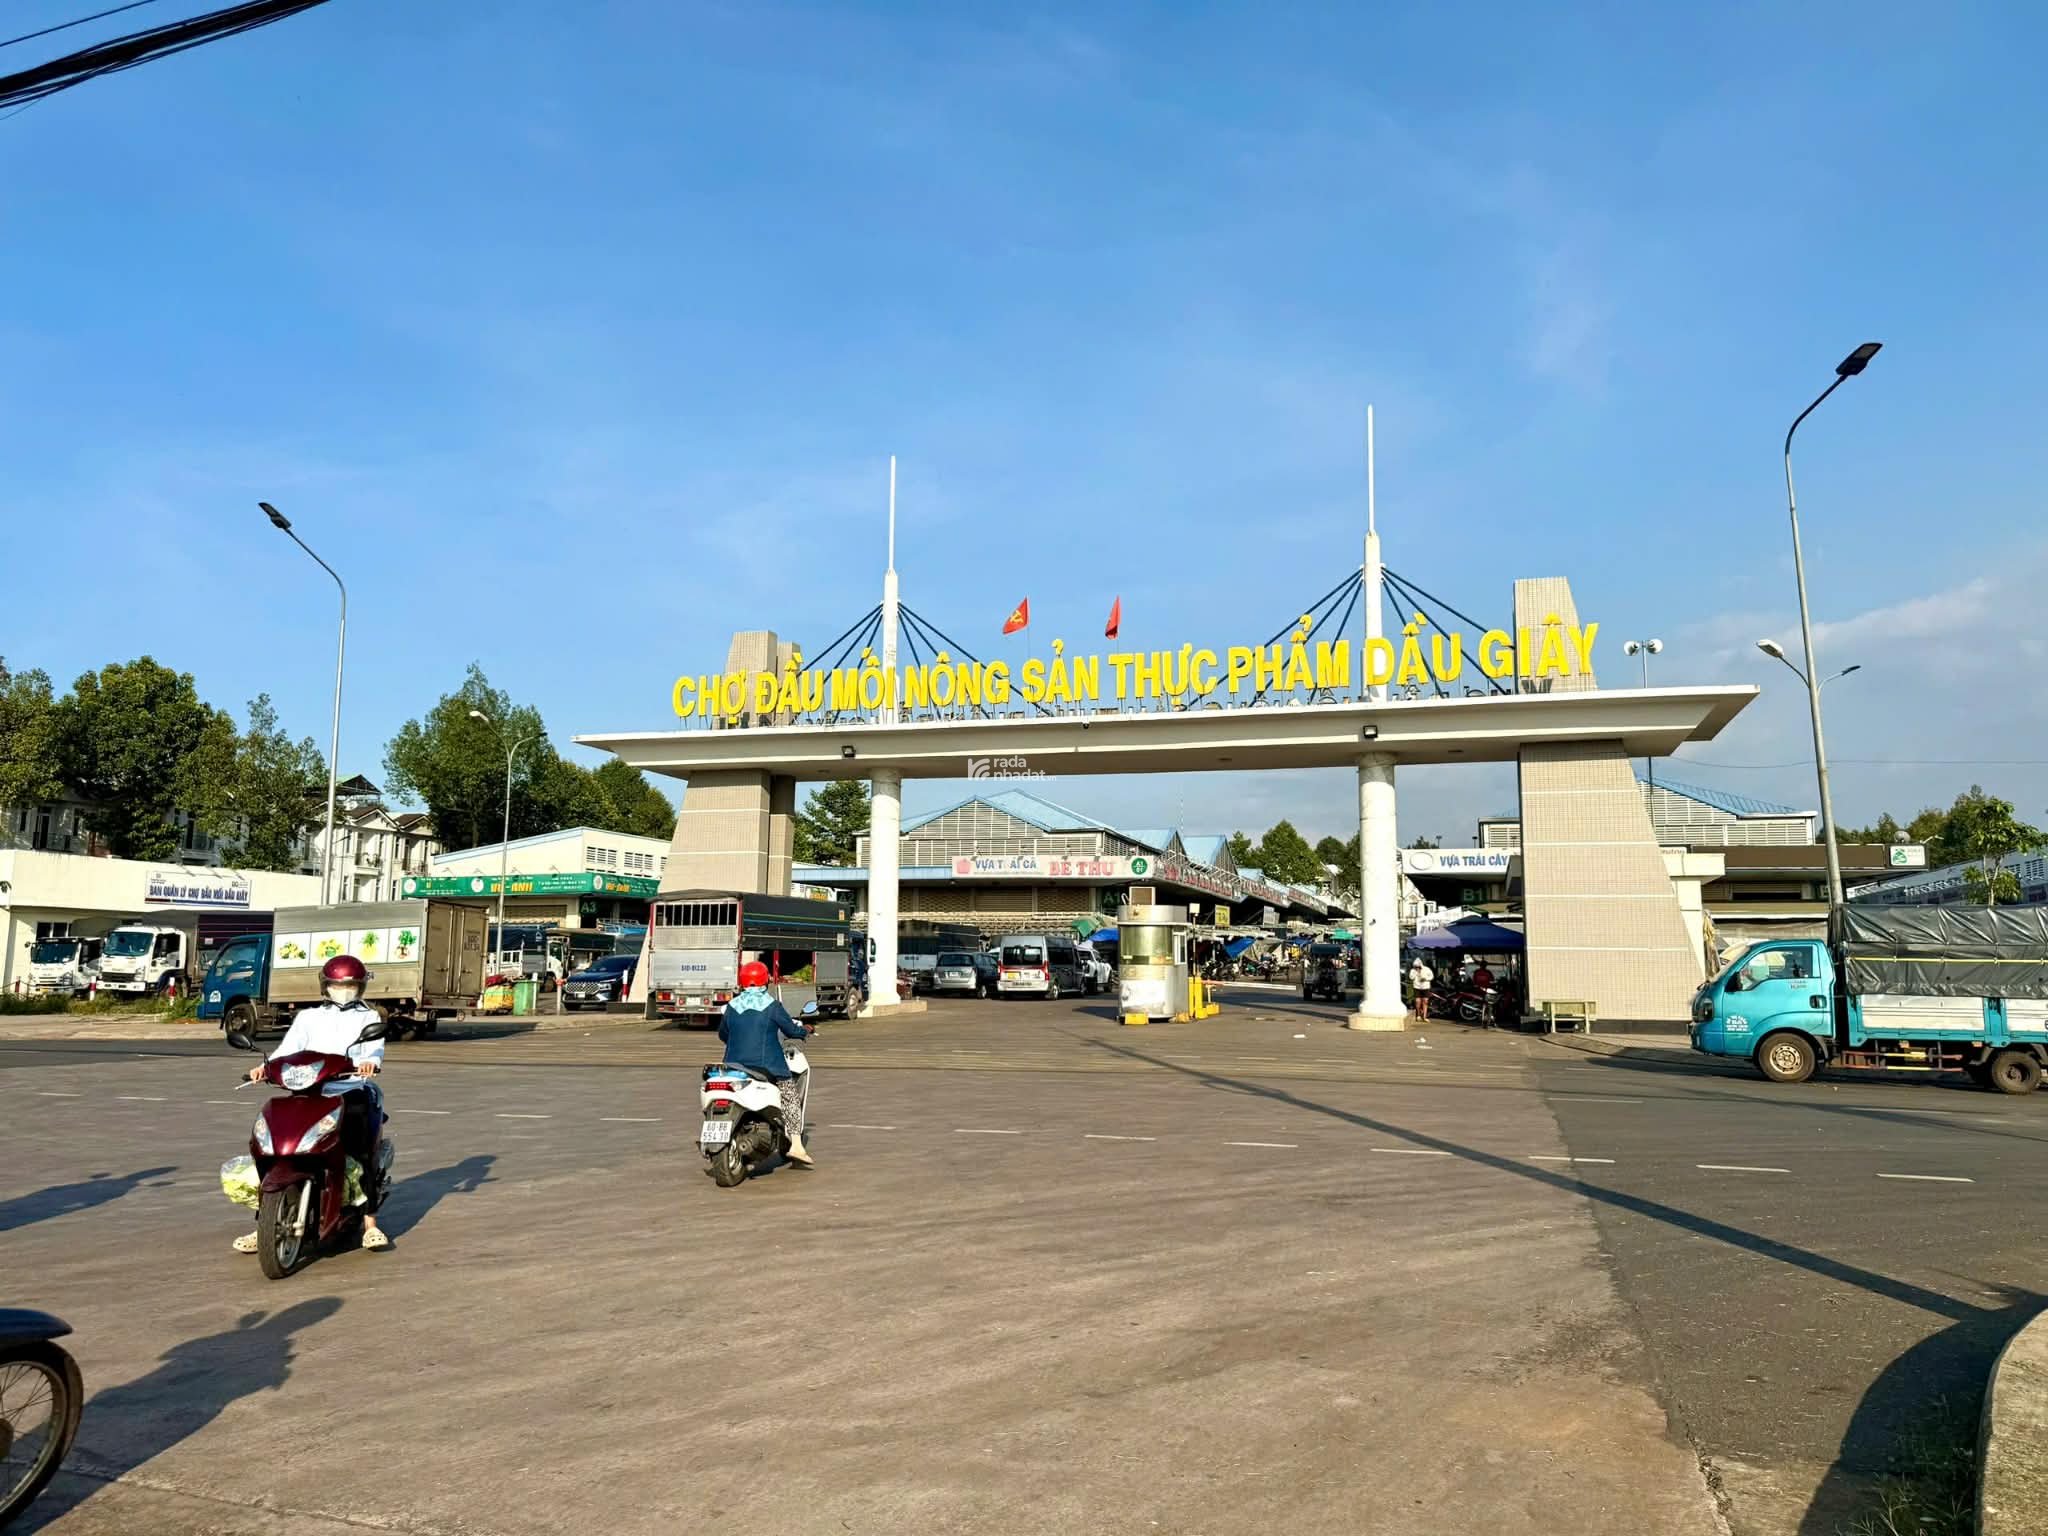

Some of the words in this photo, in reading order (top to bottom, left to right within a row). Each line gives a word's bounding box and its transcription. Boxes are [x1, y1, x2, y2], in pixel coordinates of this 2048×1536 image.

[672, 668, 748, 724] CHỢ
[755, 652, 824, 714] ĐẦU
[831, 647, 895, 711] MỐI
[904, 651, 1010, 708] NÔNG
[1022, 639, 1099, 703] SẢN
[1108, 642, 1217, 706] THỰC
[1228, 614, 1349, 693] PHẨM
[1365, 612, 1462, 687] DẦU
[1478, 612, 1600, 678] GIÂY
[975, 858, 995, 871] VỰA
[1440, 854, 1461, 868] VỰA
[1462, 854, 1485, 866] TRÁI
[1489, 853, 1508, 866] CÂY
[1463, 888, 1483, 901] B1
[581, 902, 597, 913] A3
